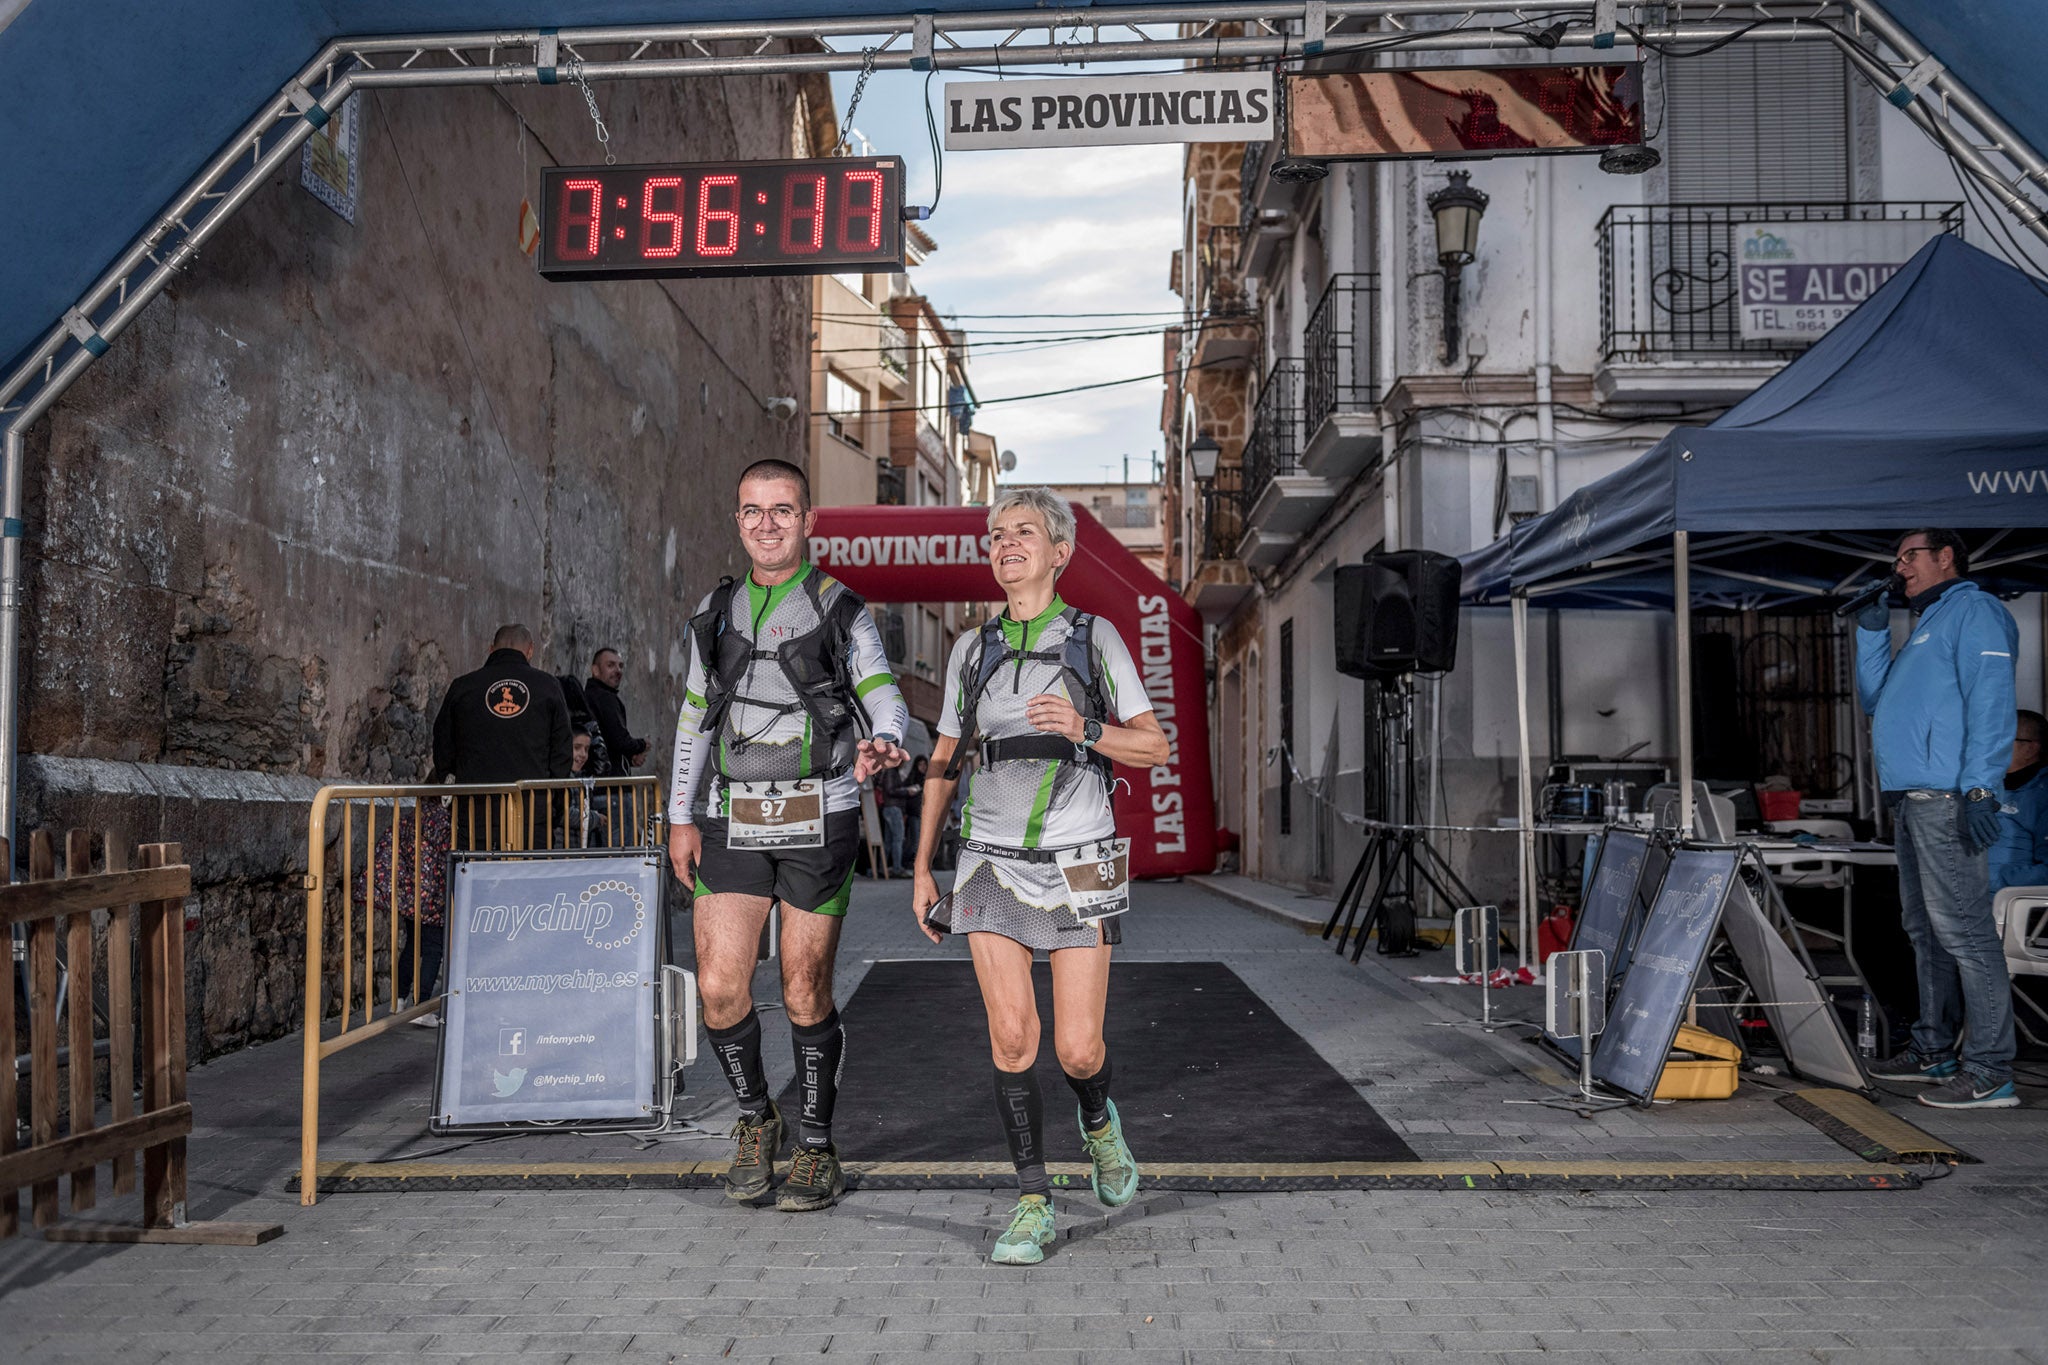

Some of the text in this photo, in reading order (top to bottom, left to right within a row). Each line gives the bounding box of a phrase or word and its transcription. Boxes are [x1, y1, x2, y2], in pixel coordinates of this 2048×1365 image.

[950, 88, 1269, 133] LAS PROVINCIAS
[565, 170, 883, 257] 7:56:17
[1748, 268, 1788, 301] SE
[1796, 308, 1825, 319] 651
[1796, 321, 1828, 331] 964
[760, 799, 787, 818] 97
[1151, 791, 1187, 853] LAS
[1097, 861, 1116, 882] 98
[470, 893, 614, 941] mychip
[466, 969, 640, 994] www.mychip.es
[536, 1033, 596, 1046] /infomychip
[533, 1073, 606, 1087] @Mychip_Info
